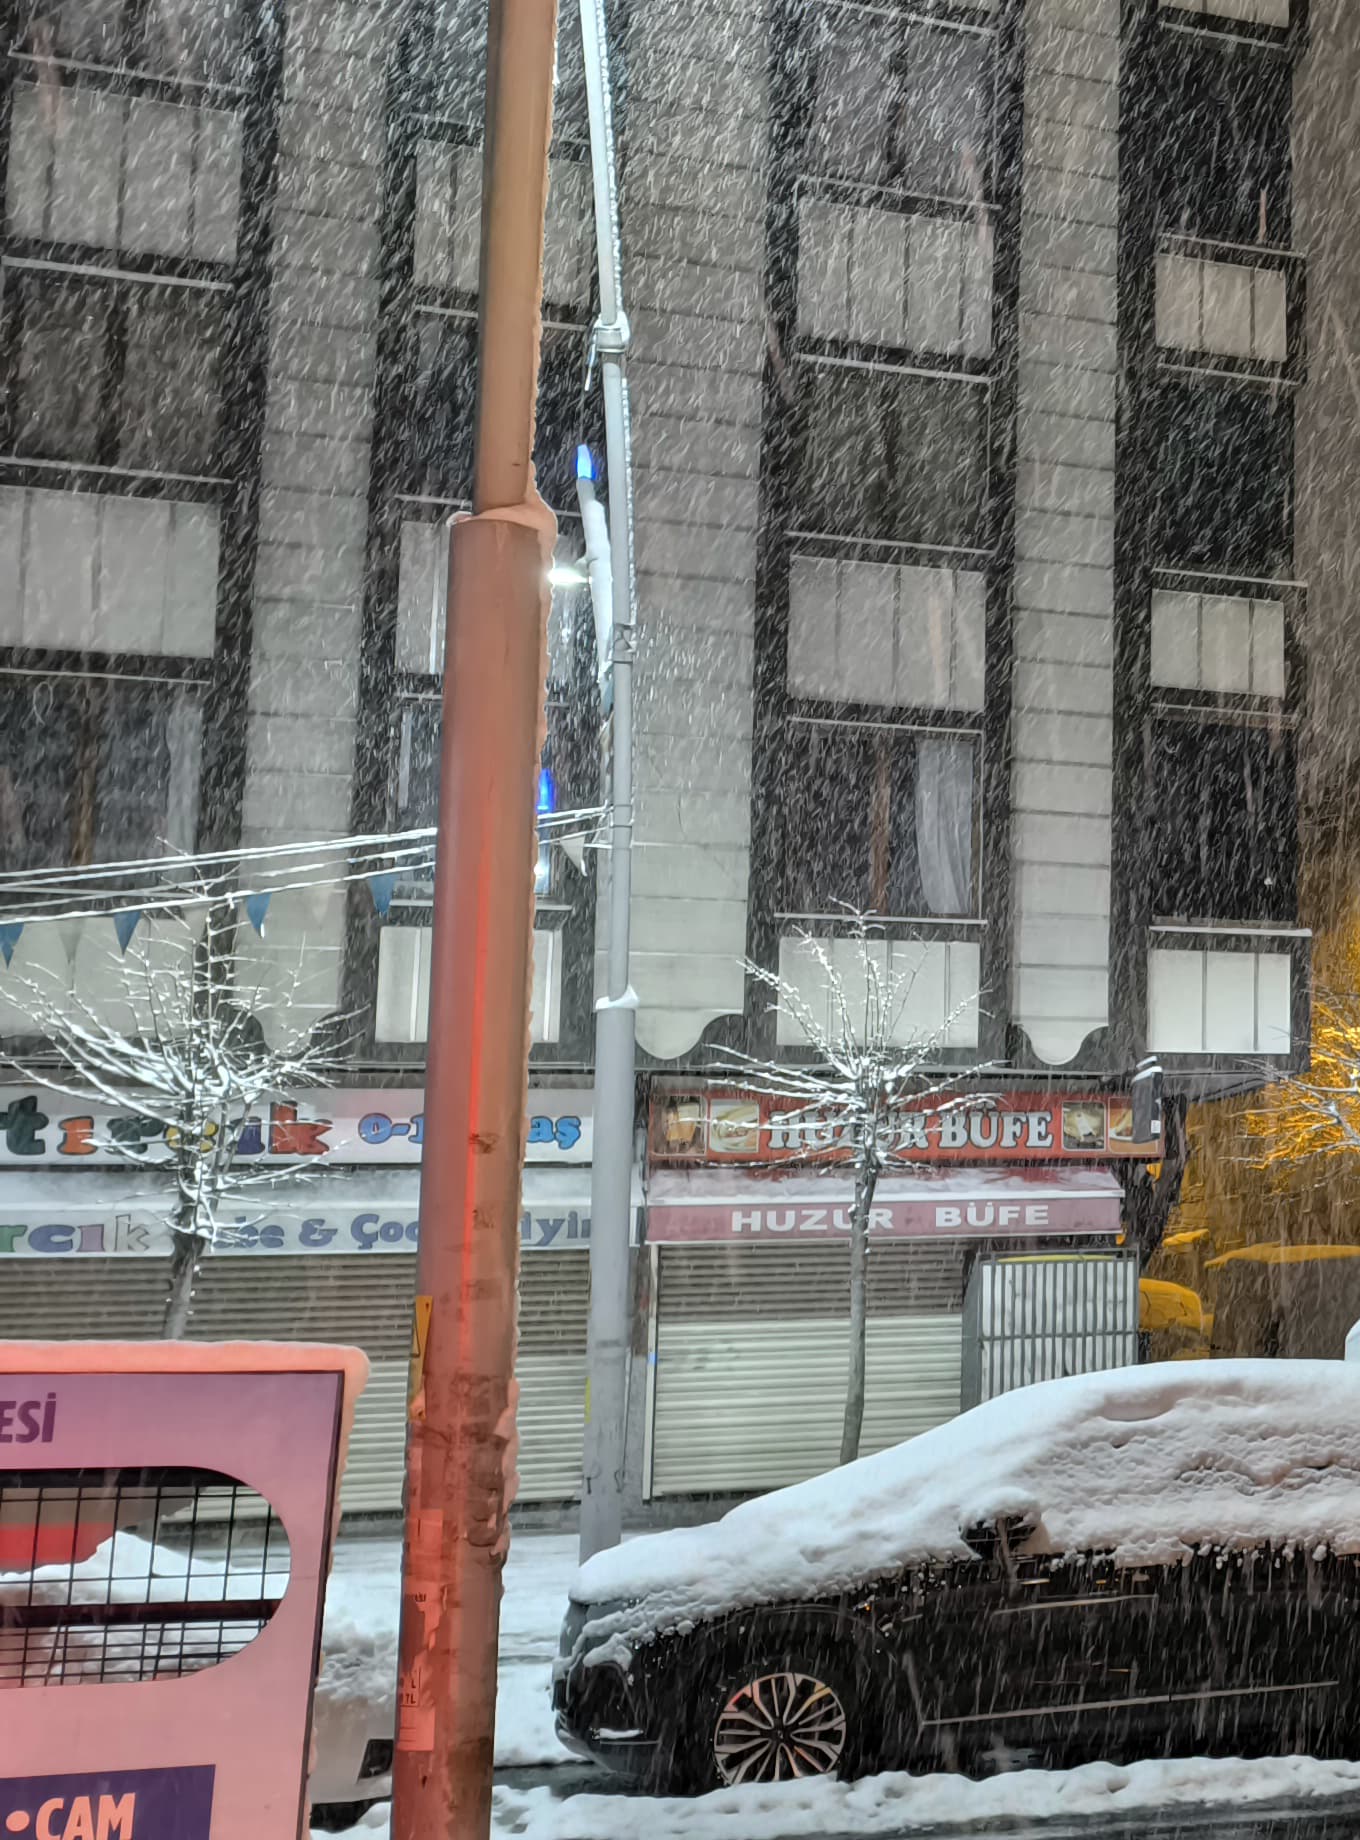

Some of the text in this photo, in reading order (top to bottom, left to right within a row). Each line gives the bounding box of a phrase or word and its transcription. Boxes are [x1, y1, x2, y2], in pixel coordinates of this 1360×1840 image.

[526, 1115, 582, 1150] aş
[768, 1101, 1053, 1149] HUZUR BÜFE
[731, 1202, 1049, 1233] HUZUR BÜFE
